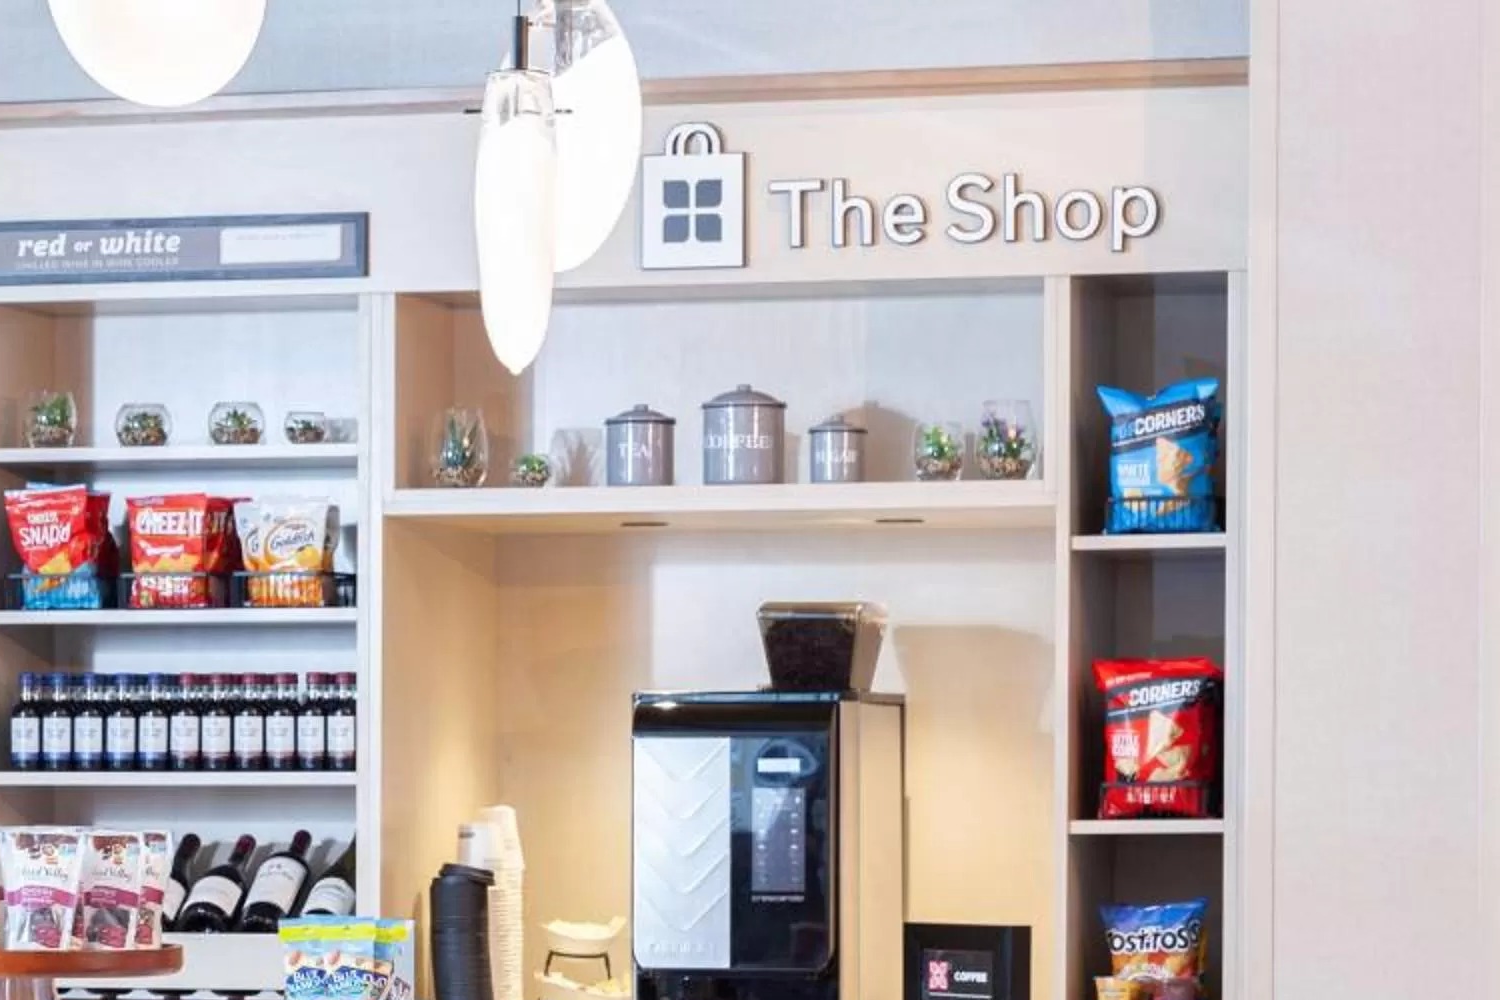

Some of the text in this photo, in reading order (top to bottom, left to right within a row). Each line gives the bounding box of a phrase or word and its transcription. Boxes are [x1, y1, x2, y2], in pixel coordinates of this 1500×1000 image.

[768, 172, 1161, 252] The Shop
[17, 230, 181, 258] red or white
[617, 443, 651, 458] TEA
[953, 971, 988, 983] COFFEE
